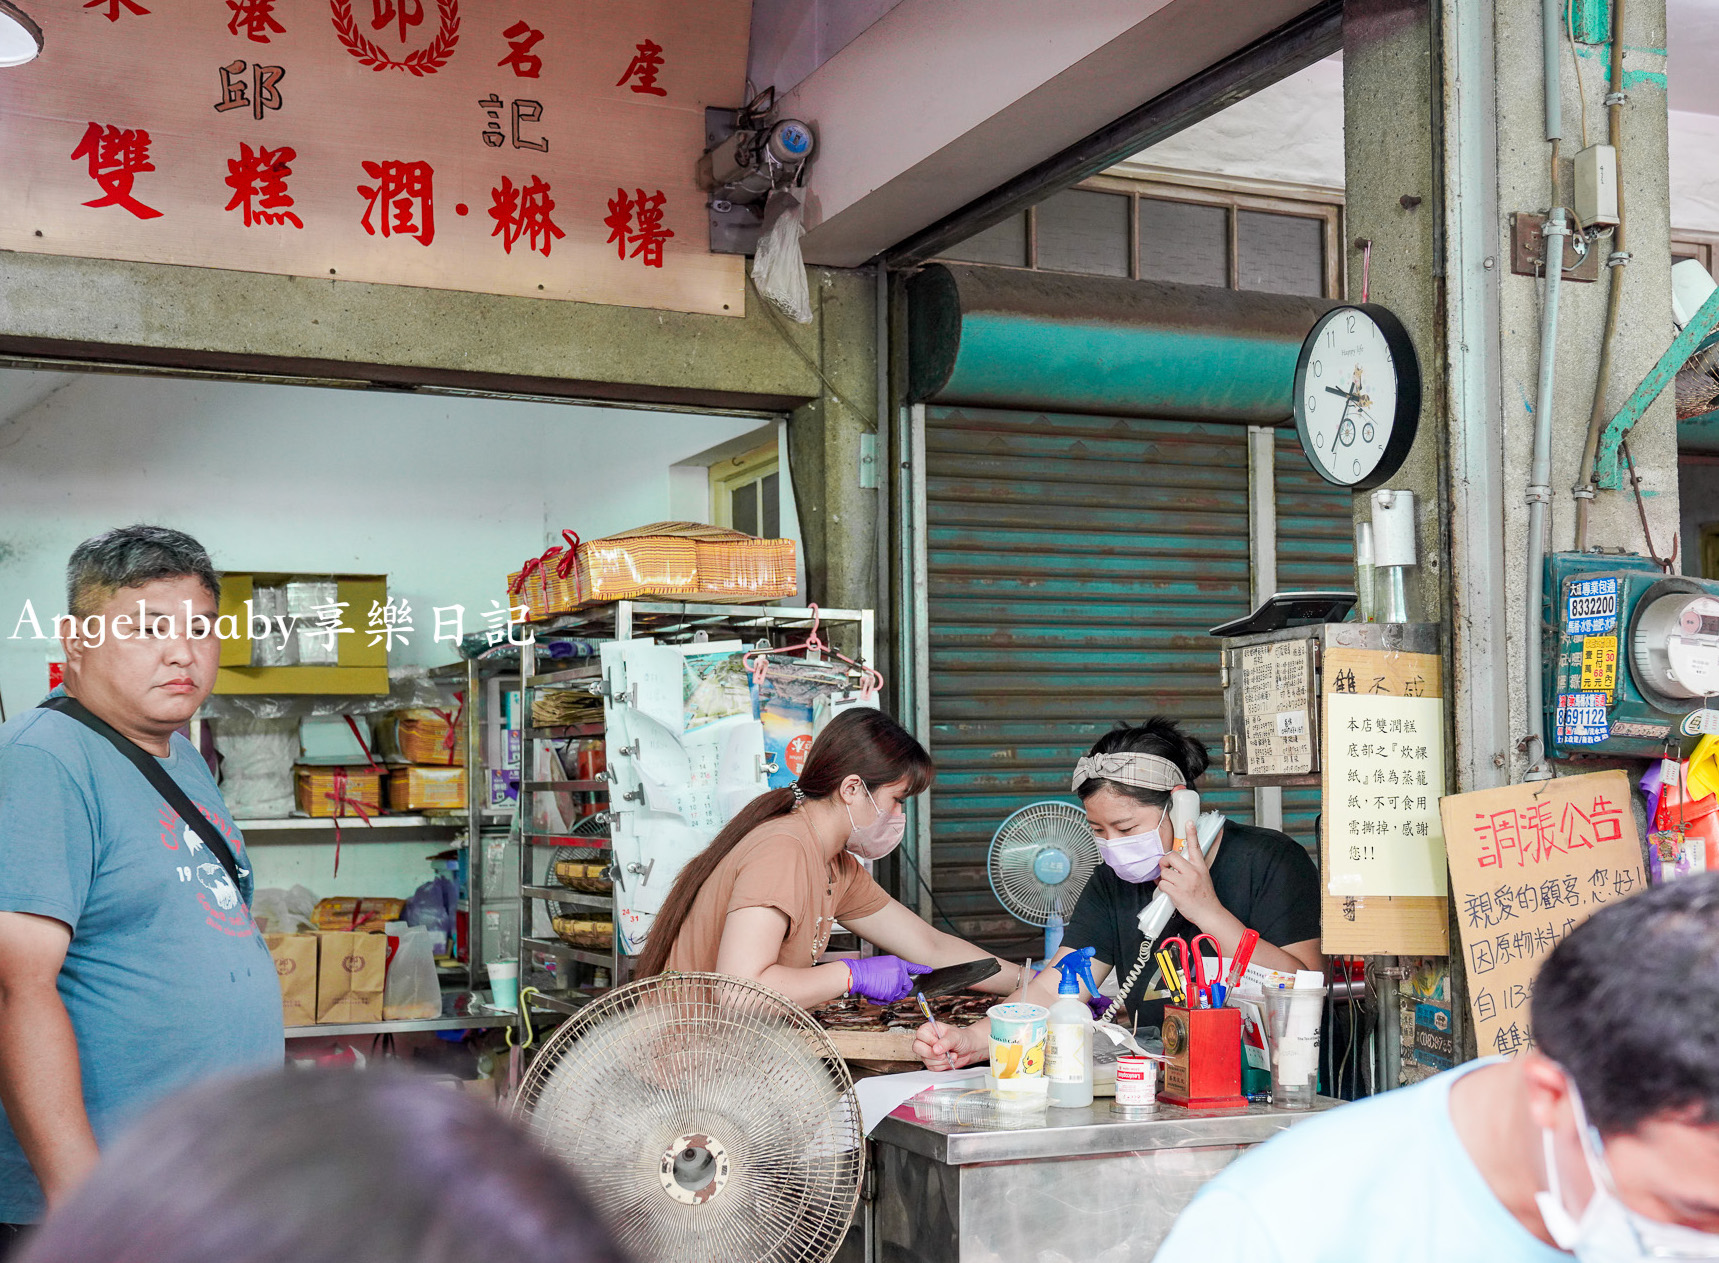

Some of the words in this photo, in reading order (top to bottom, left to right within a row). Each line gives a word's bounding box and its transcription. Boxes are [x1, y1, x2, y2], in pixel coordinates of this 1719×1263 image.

[1345, 315, 1356, 334] 12
[1326, 330, 1336, 349] 11
[1312, 359, 1323, 378] 10
[1571, 596, 1615, 617] 8332200
[1347, 717, 1417, 734] 本店雙潤糕
[1558, 708, 1606, 727] 8691122
[1348, 821, 1429, 837] 需撕掉,感謝
[1474, 795, 1623, 869] 調漲公告
[622, 908, 630, 916] 24
[629, 915, 639, 923] 31
